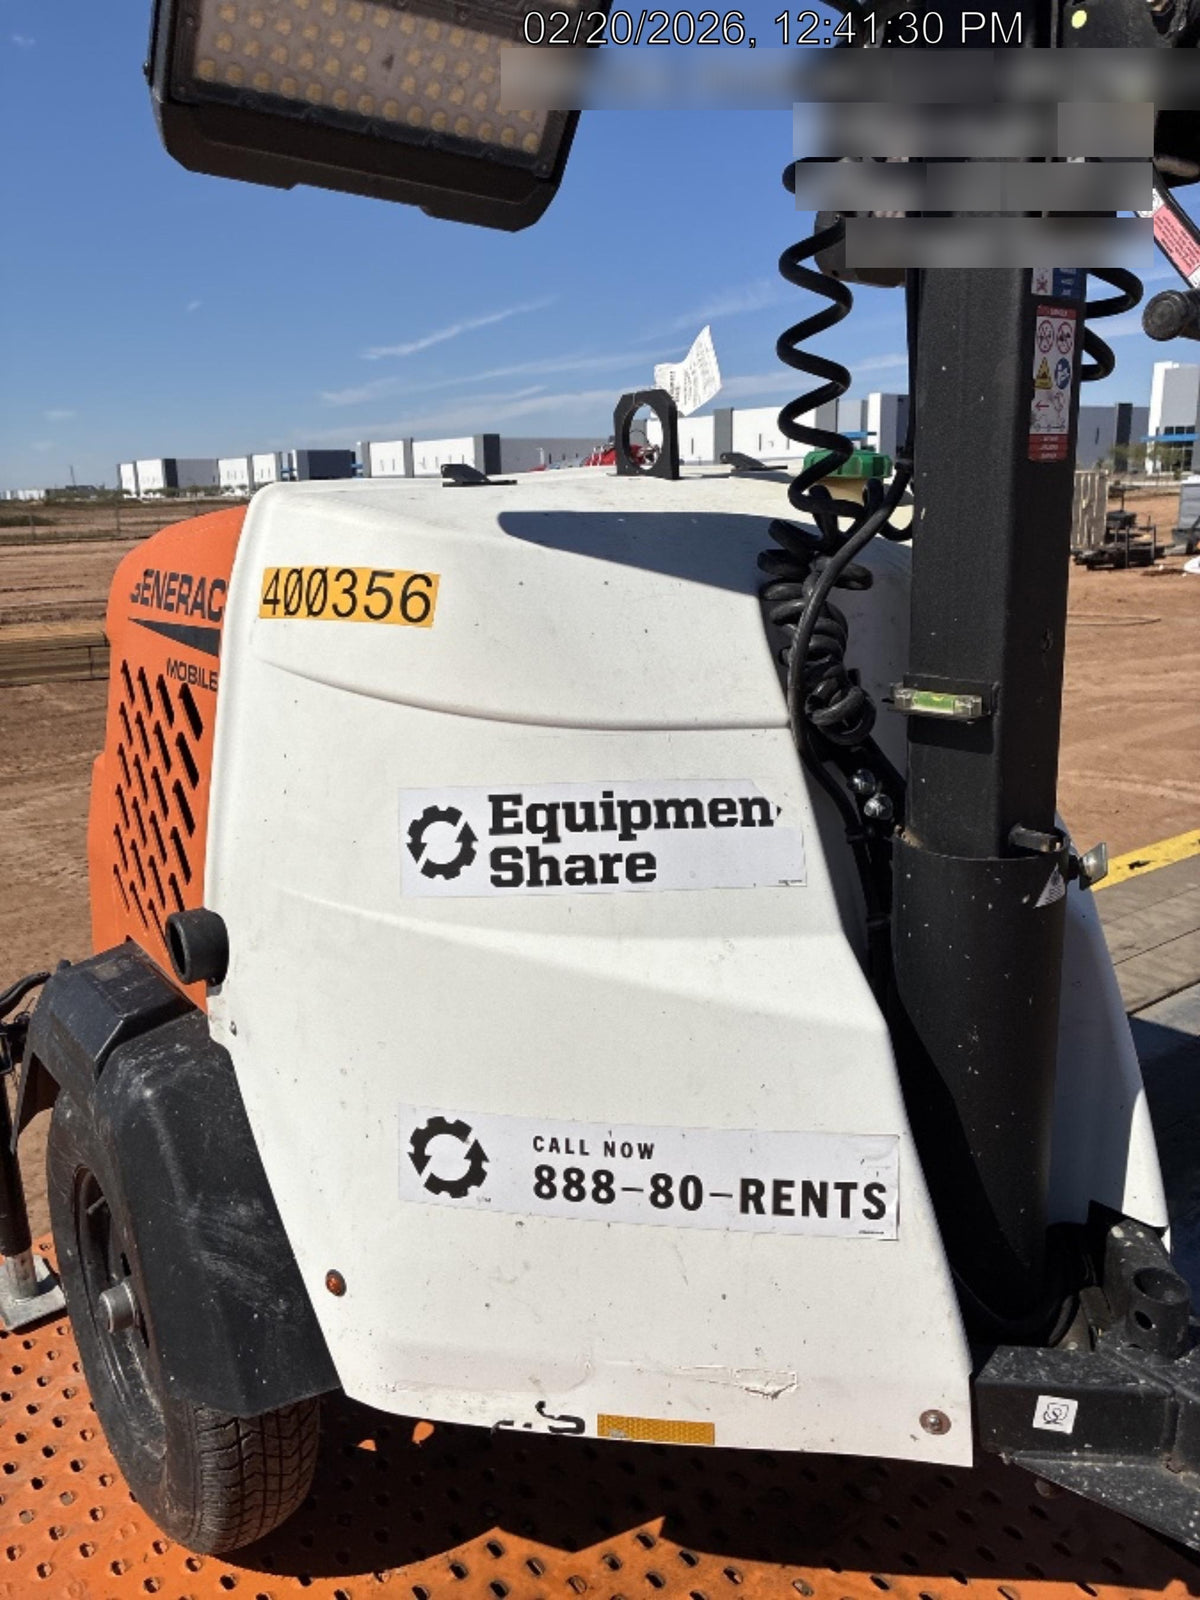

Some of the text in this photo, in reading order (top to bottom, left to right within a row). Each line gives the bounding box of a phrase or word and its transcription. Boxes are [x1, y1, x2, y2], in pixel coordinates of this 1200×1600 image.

[262, 568, 434, 623] 400356
[166, 658, 218, 692] MOBILE
[488, 791, 782, 844] Equipmen
[489, 845, 656, 888] Share
[533, 1136, 655, 1159] CALL NOW
[533, 1164, 887, 1220] 888-80-RENTS
